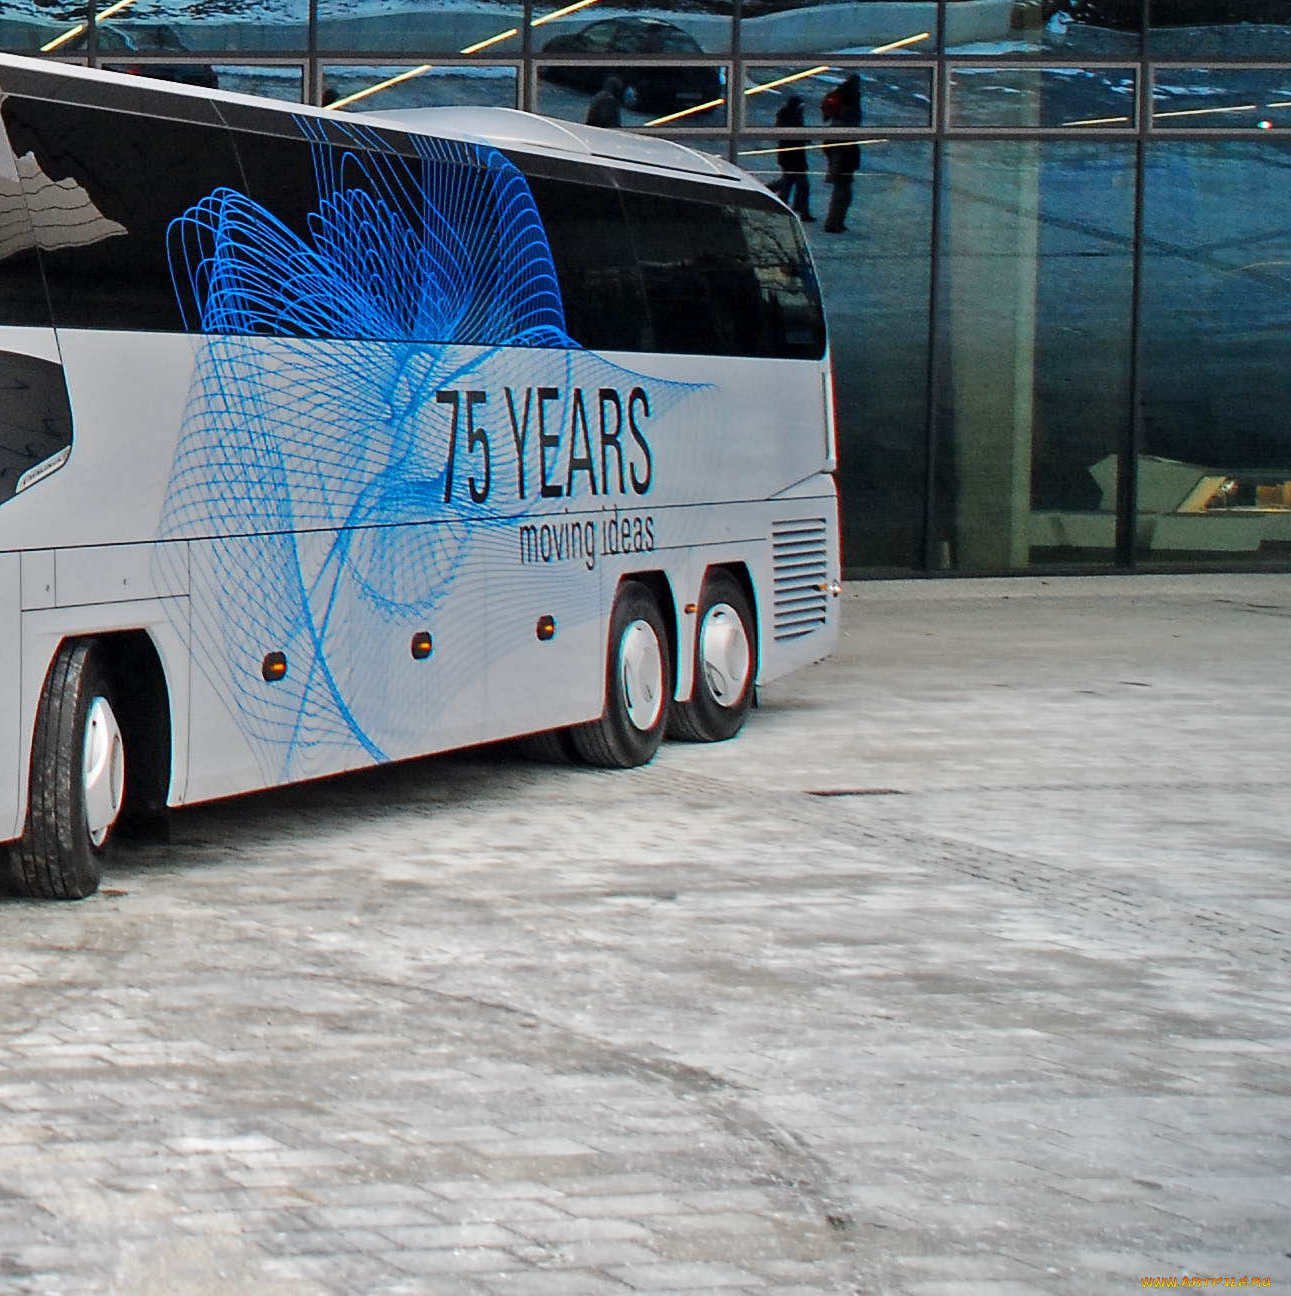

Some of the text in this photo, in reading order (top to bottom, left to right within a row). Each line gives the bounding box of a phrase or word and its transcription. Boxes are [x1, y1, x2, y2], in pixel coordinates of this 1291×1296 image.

[436, 387, 652, 503] 75 YEARS
[519, 504, 654, 570] moving ideas
